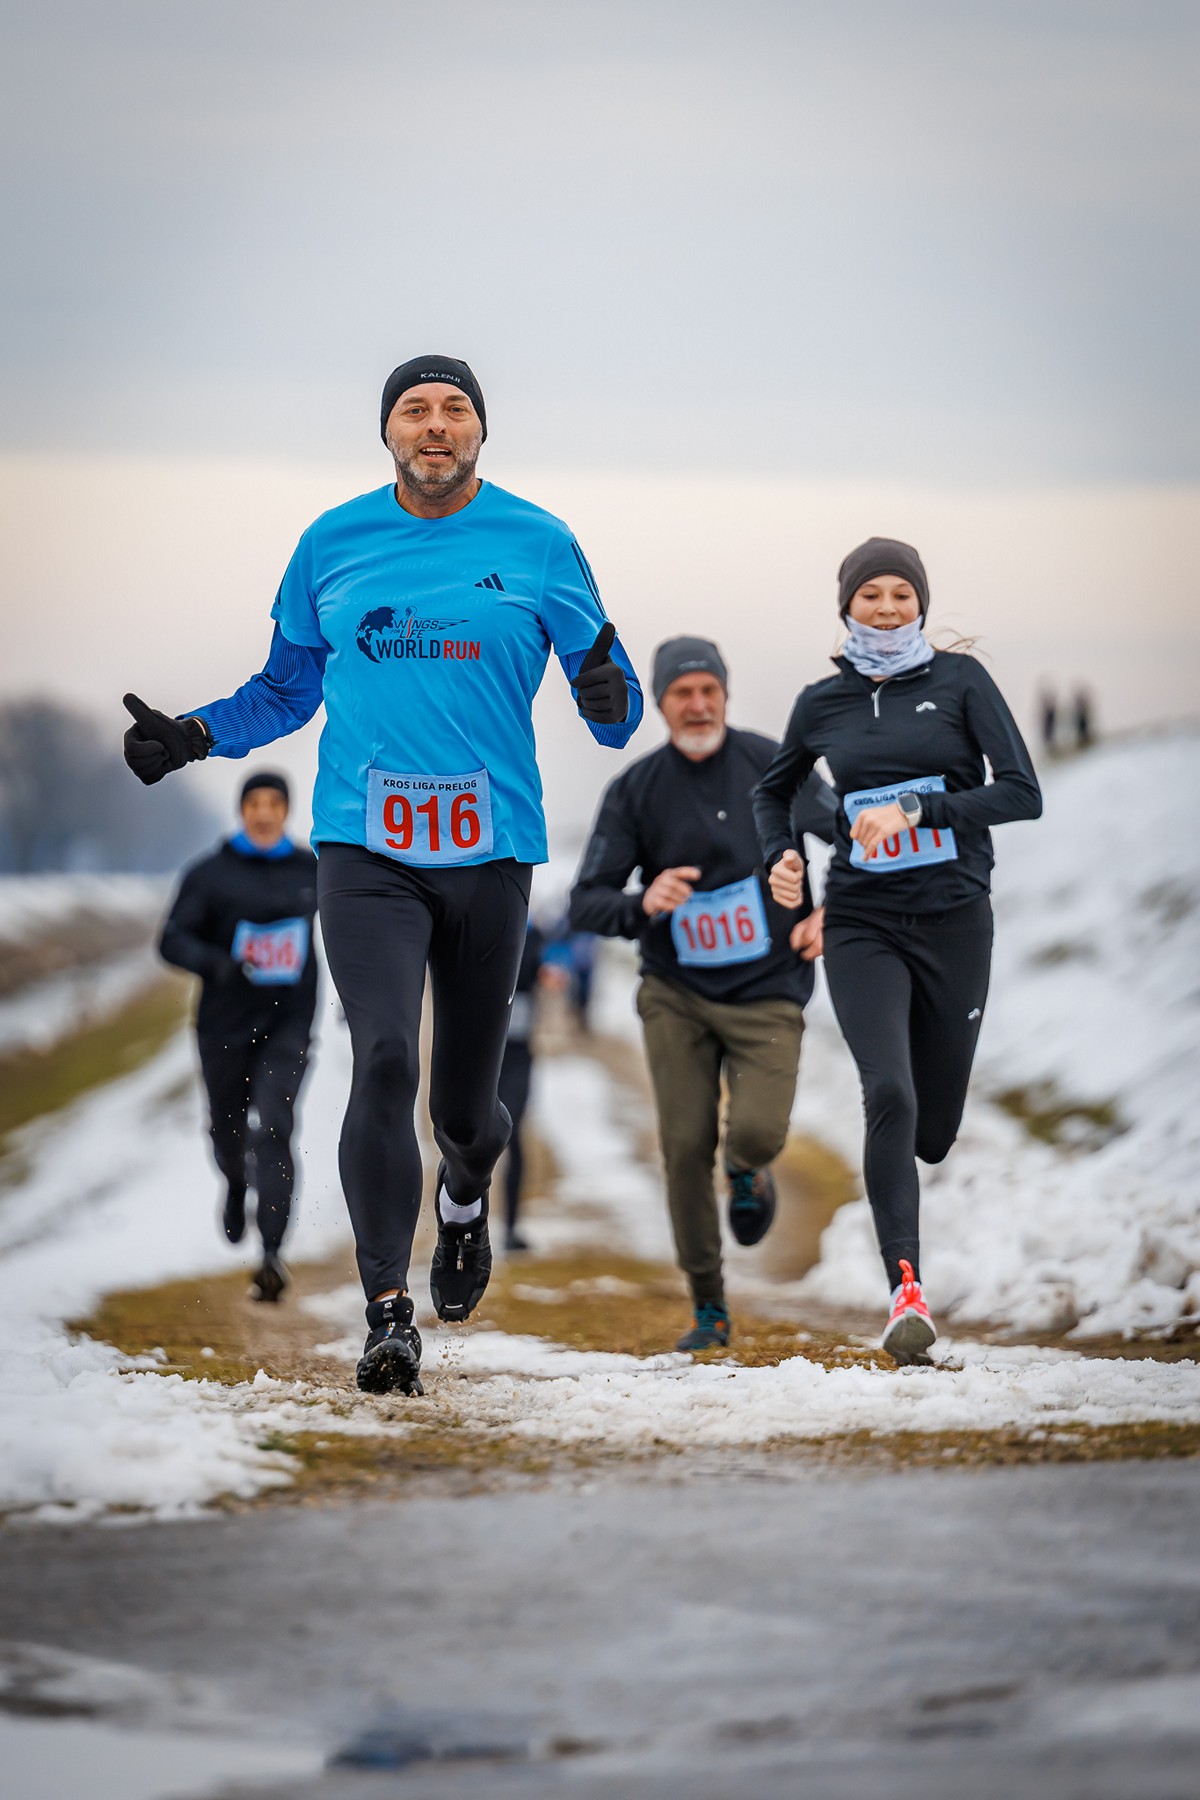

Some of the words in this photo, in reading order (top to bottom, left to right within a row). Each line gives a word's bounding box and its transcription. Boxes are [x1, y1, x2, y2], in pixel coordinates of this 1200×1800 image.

[421, 373, 460, 383] KALENJI
[394, 620, 439, 629] WINGS
[400, 630, 425, 638] LIFE
[376, 639, 441, 659] WORLD
[443, 640, 481, 660] RUN
[383, 779, 410, 789] KROS
[412, 781, 436, 791] LIGA
[438, 780, 477, 791] PRELOG
[875, 794, 896, 803] LIGA
[383, 792, 481, 852] 916
[679, 905, 755, 950] 1016
